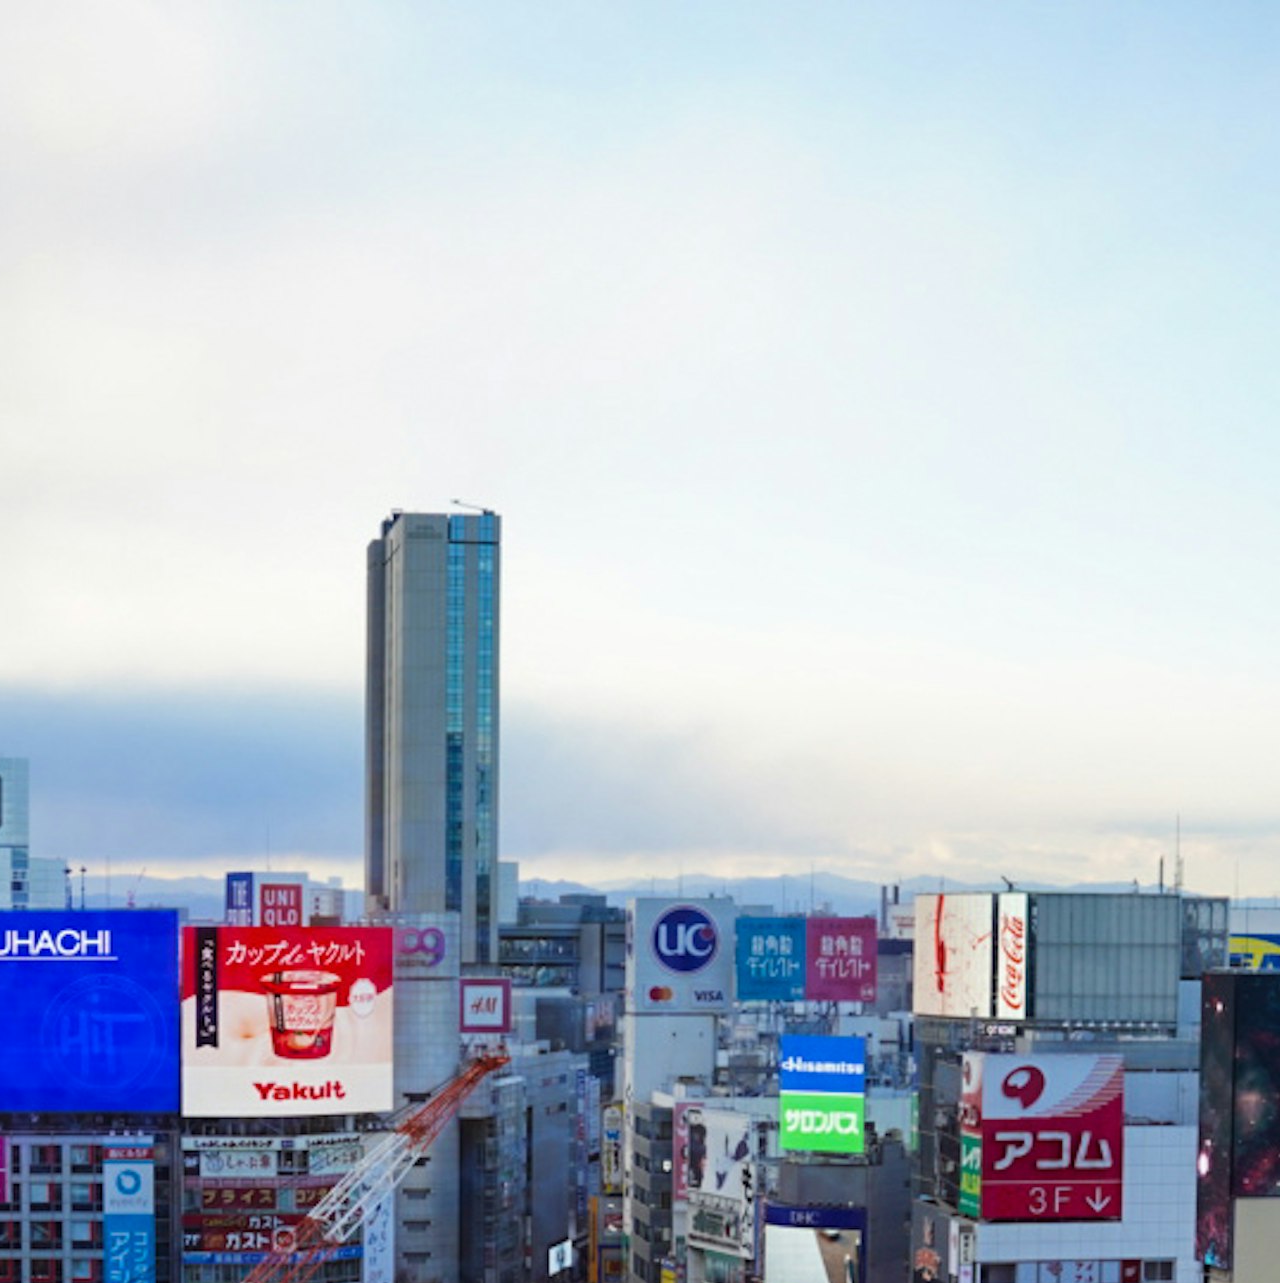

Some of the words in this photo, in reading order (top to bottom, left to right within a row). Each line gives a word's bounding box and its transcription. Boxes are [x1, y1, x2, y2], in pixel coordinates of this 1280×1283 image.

[264, 889, 295, 906] UNI
[264, 908, 298, 927] QLO
[694, 989, 724, 1002] VISA
[782, 1056, 864, 1075] Hisamitsu
[253, 1081, 345, 1101] Yakult
[785, 1109, 859, 1135] サロンパス
[993, 1130, 1112, 1170] アコム
[1028, 1186, 1073, 1214] 3F
[248, 1216, 285, 1230] ガスト
[790, 1211, 819, 1224] DHC
[225, 1232, 270, 1249] ガスト
